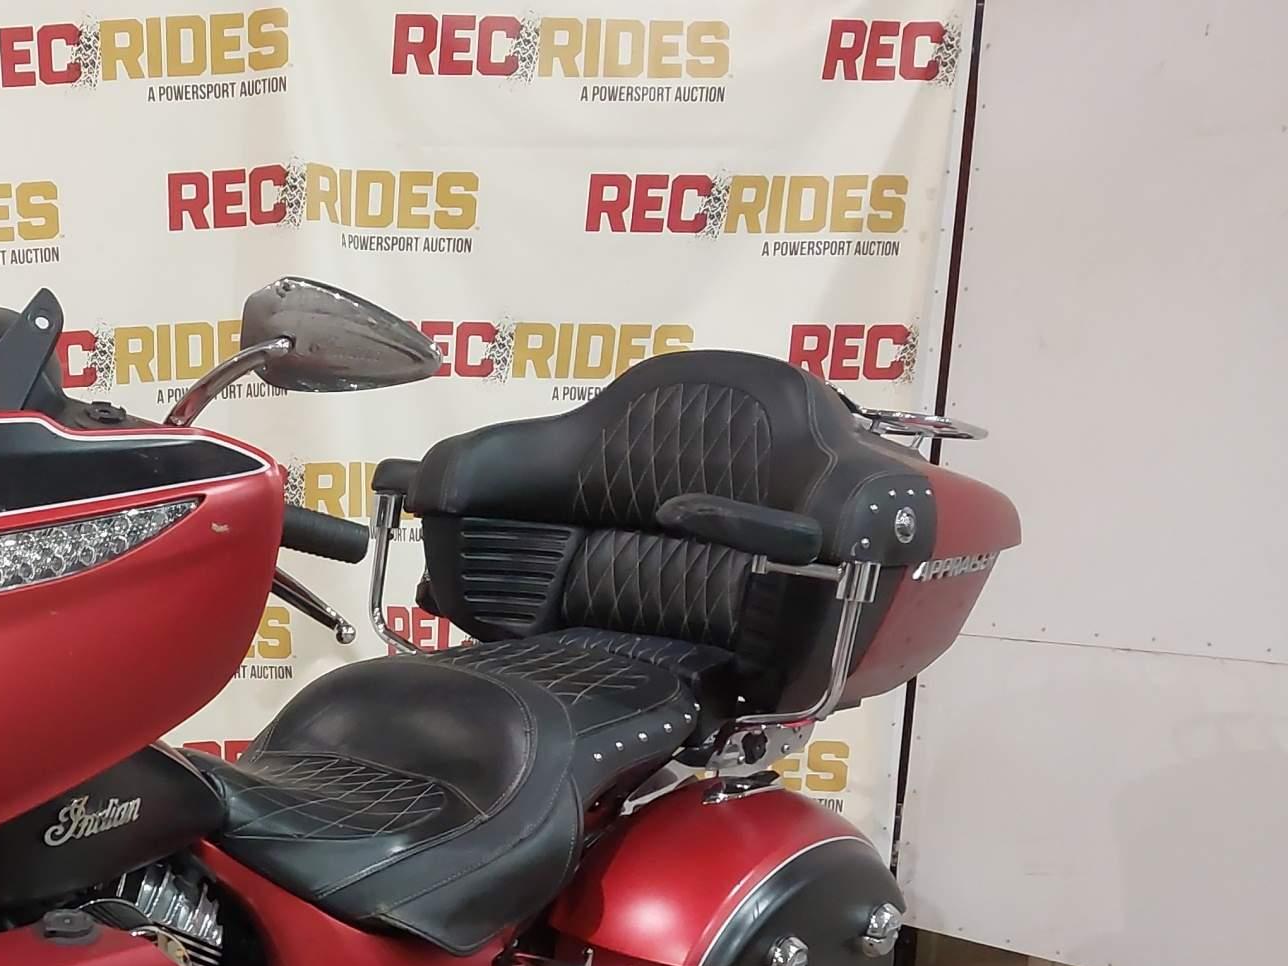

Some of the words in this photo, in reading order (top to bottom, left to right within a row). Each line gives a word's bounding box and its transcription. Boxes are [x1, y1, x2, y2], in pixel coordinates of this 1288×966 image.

[97, 8, 289, 81] RIDES
[392, 14, 516, 76] REC
[541, 18, 728, 77] RIDES
[822, 19, 947, 81] REC
[147, 86, 156, 102] A
[158, 82, 236, 102] POWERSPORT
[239, 76, 287, 97] AUCTION
[580, 86, 588, 102] A
[591, 85, 672, 102] POWERSPORT
[674, 86, 726, 102] AUCTION
[167, 164, 287, 231] REC
[304, 164, 479, 230] RIDES
[584, 173, 713, 234] REC
[724, 175, 909, 234] RIDES
[10, 246, 60, 265] AUCTION
[340, 234, 350, 250] A
[349, 234, 420, 253] POWERSPORT
[422, 237, 472, 253] AUCTION
[761, 241, 770, 257] A
[773, 240, 853, 256] POWERSPORT
[853, 240, 900, 256] AUCTION
[788, 324, 912, 381] REC
[551, 386, 559, 401] A
[249, 665, 293, 680] AUCTION
[43, 796, 142, 847] Indian
